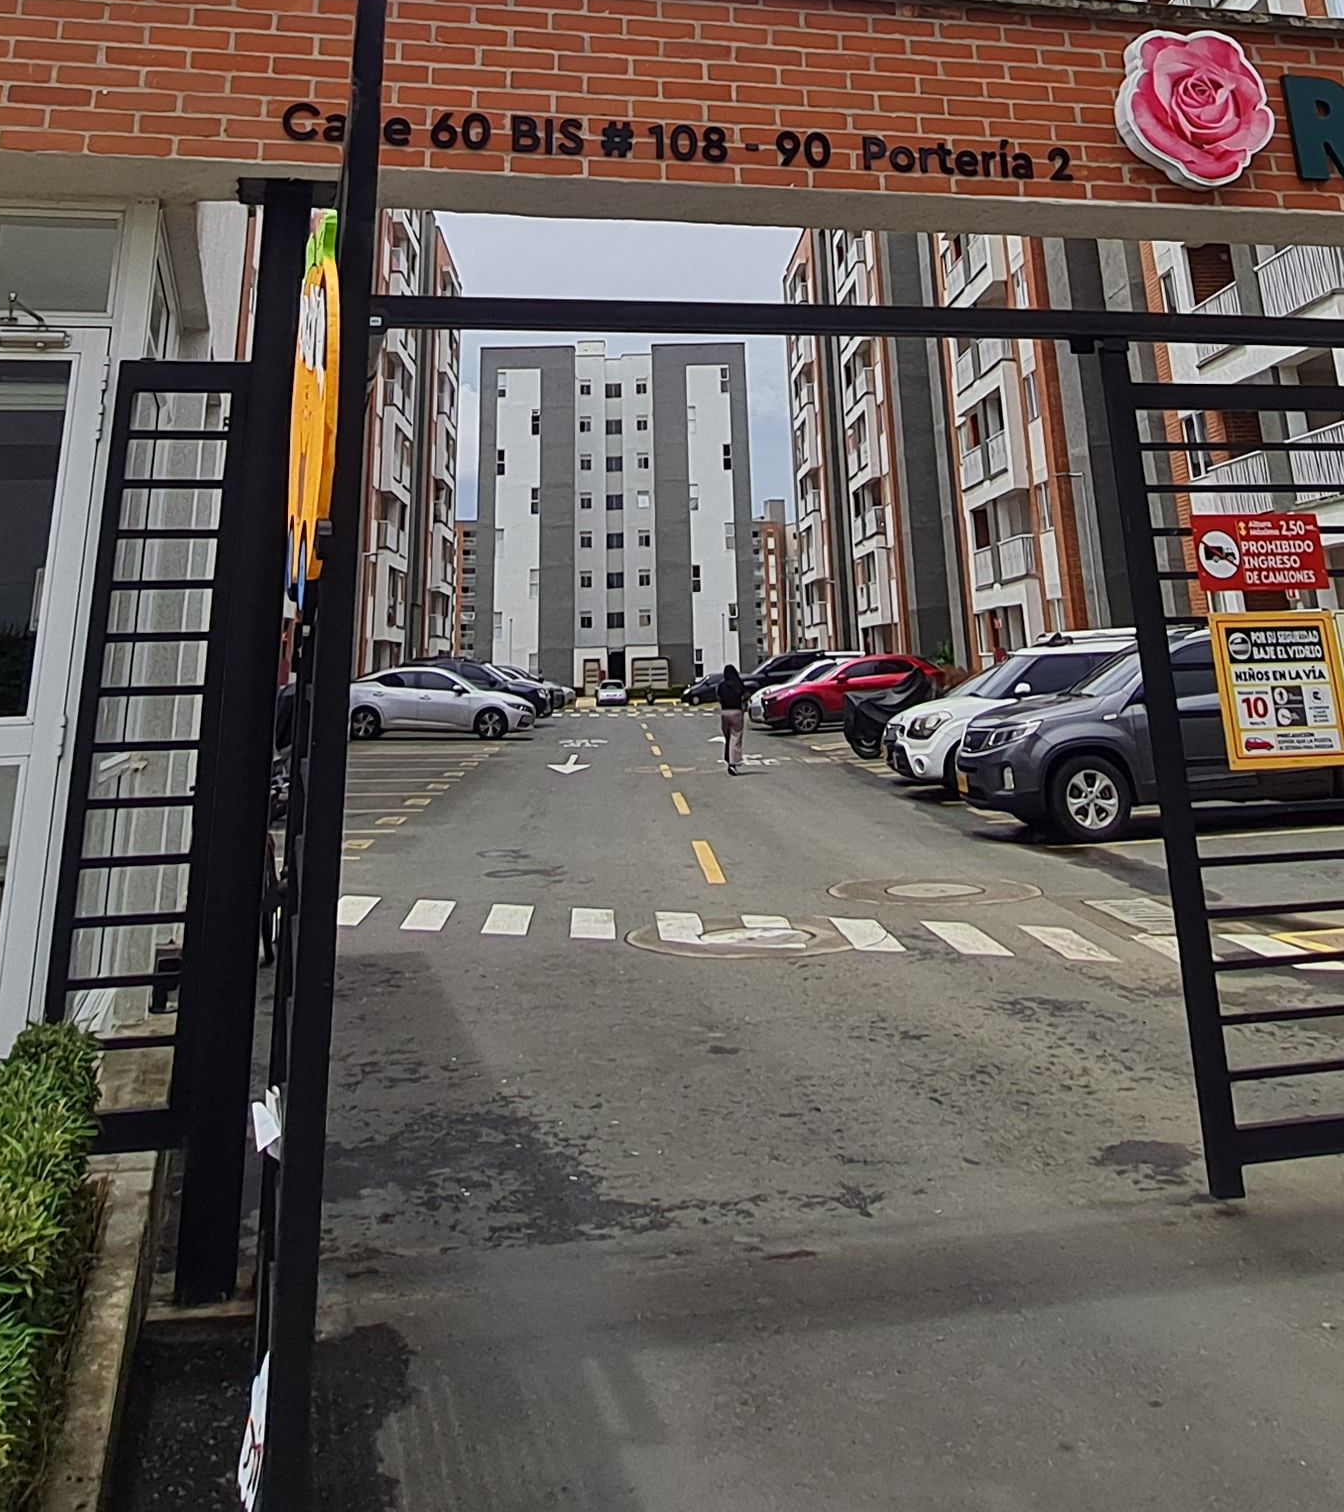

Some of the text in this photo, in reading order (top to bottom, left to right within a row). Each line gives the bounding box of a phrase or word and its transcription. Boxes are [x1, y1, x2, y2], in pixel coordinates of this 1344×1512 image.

[282, 102, 412, 146] Cae
[430, 111, 491, 150] 60
[511, 115, 584, 156] BIS
[601, 121, 634, 159] #
[648, 124, 728, 164] 108
[777, 129, 832, 169] 90
[862, 139, 1035, 180] Portería
[1048, 146, 1073, 183] 2
[1241, 539, 1314, 554] PROHIBIDO
[1242, 555, 1301, 569] INGRESO
[1246, 569, 1316, 584] DE CAMIONES
[1250, 631, 1266, 644] POR
[1252, 646, 1276, 659] BAJE
[1287, 645, 1322, 659] VIDRIO
[1234, 666, 1326, 682] NIÑOS EN LA VÍA
[1241, 696, 1268, 719] 10
